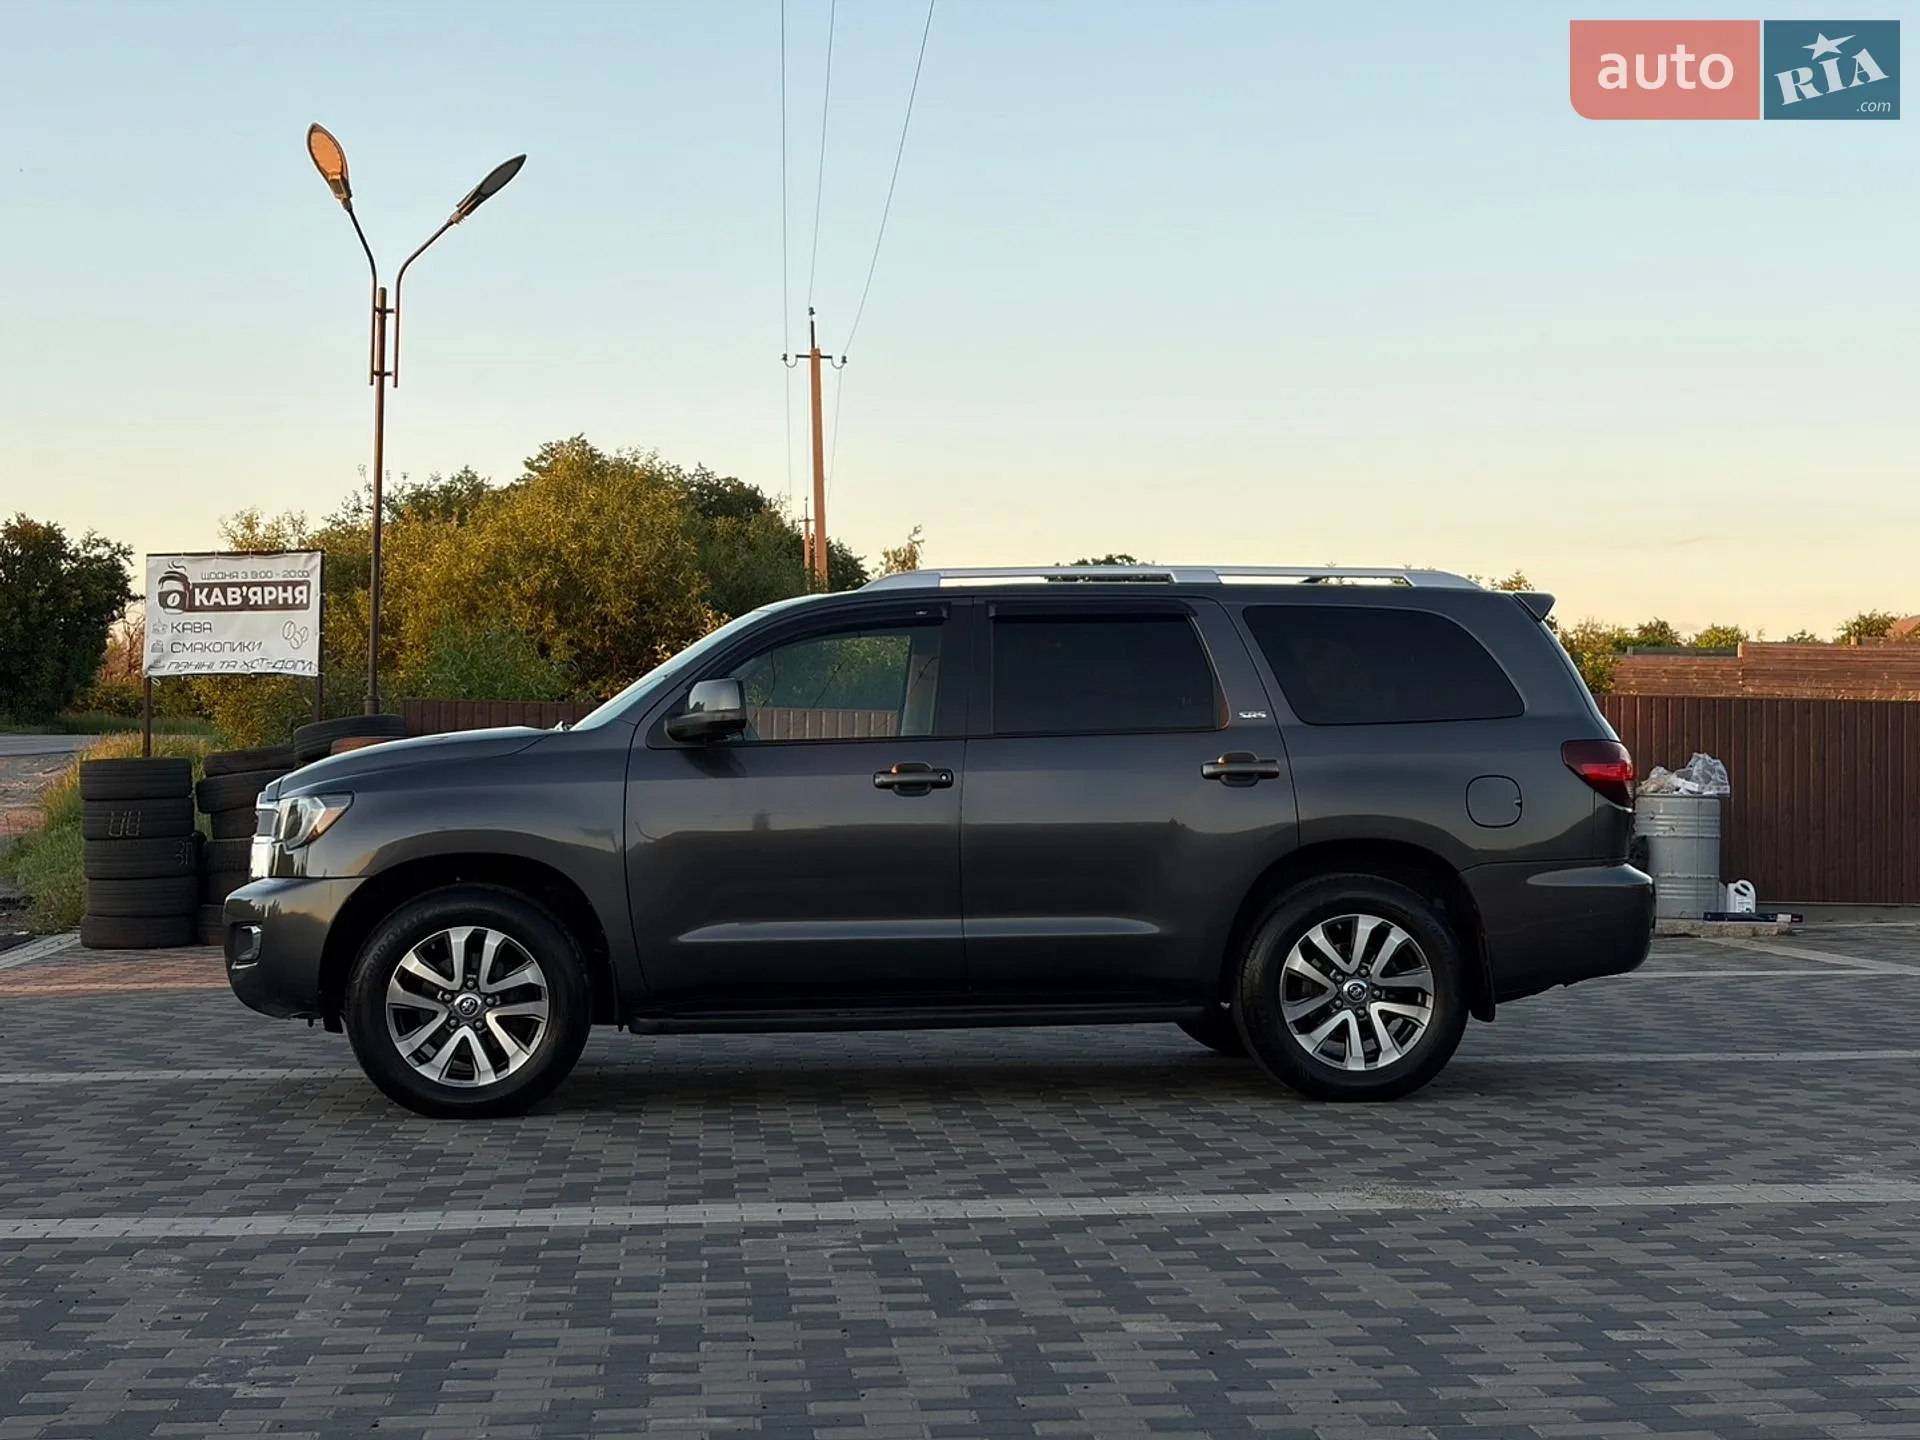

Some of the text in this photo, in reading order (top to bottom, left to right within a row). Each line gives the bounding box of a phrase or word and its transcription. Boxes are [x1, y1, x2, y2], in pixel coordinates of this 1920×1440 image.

[194, 585, 308, 607] КАВ'ЯРНЯ
[170, 621, 213, 633] КАВА
[219, 659, 239, 670] ТА
